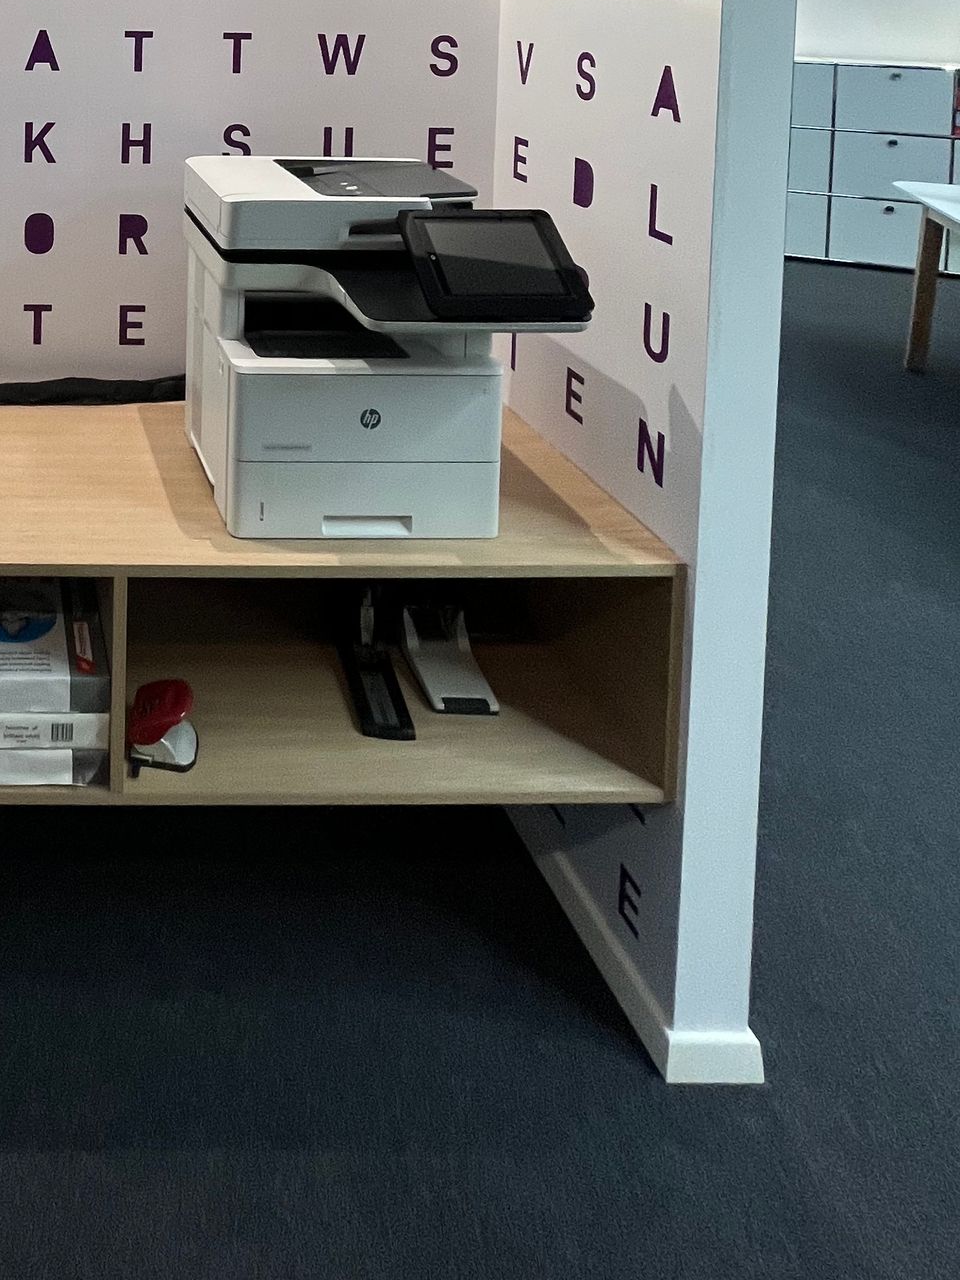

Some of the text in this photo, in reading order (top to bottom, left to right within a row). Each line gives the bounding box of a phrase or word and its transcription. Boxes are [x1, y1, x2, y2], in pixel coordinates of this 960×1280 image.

[24, 29, 61, 72] A
[124, 30, 154, 73] T
[222, 31, 253, 74] T
[317, 33, 367, 76] W
[429, 34, 459, 78] S
[516, 40, 682, 124] V S A
[23, 121, 57, 164] K
[120, 122, 152, 165] H
[426, 126, 455, 170] E
[512, 135, 529, 184] E
[648, 183, 674, 247] L
[118, 213, 149, 256] R
[23, 303, 147, 346] T E
[642, 301, 671, 364] U
[564, 366, 586, 426] E
[636, 416, 666, 489] N
